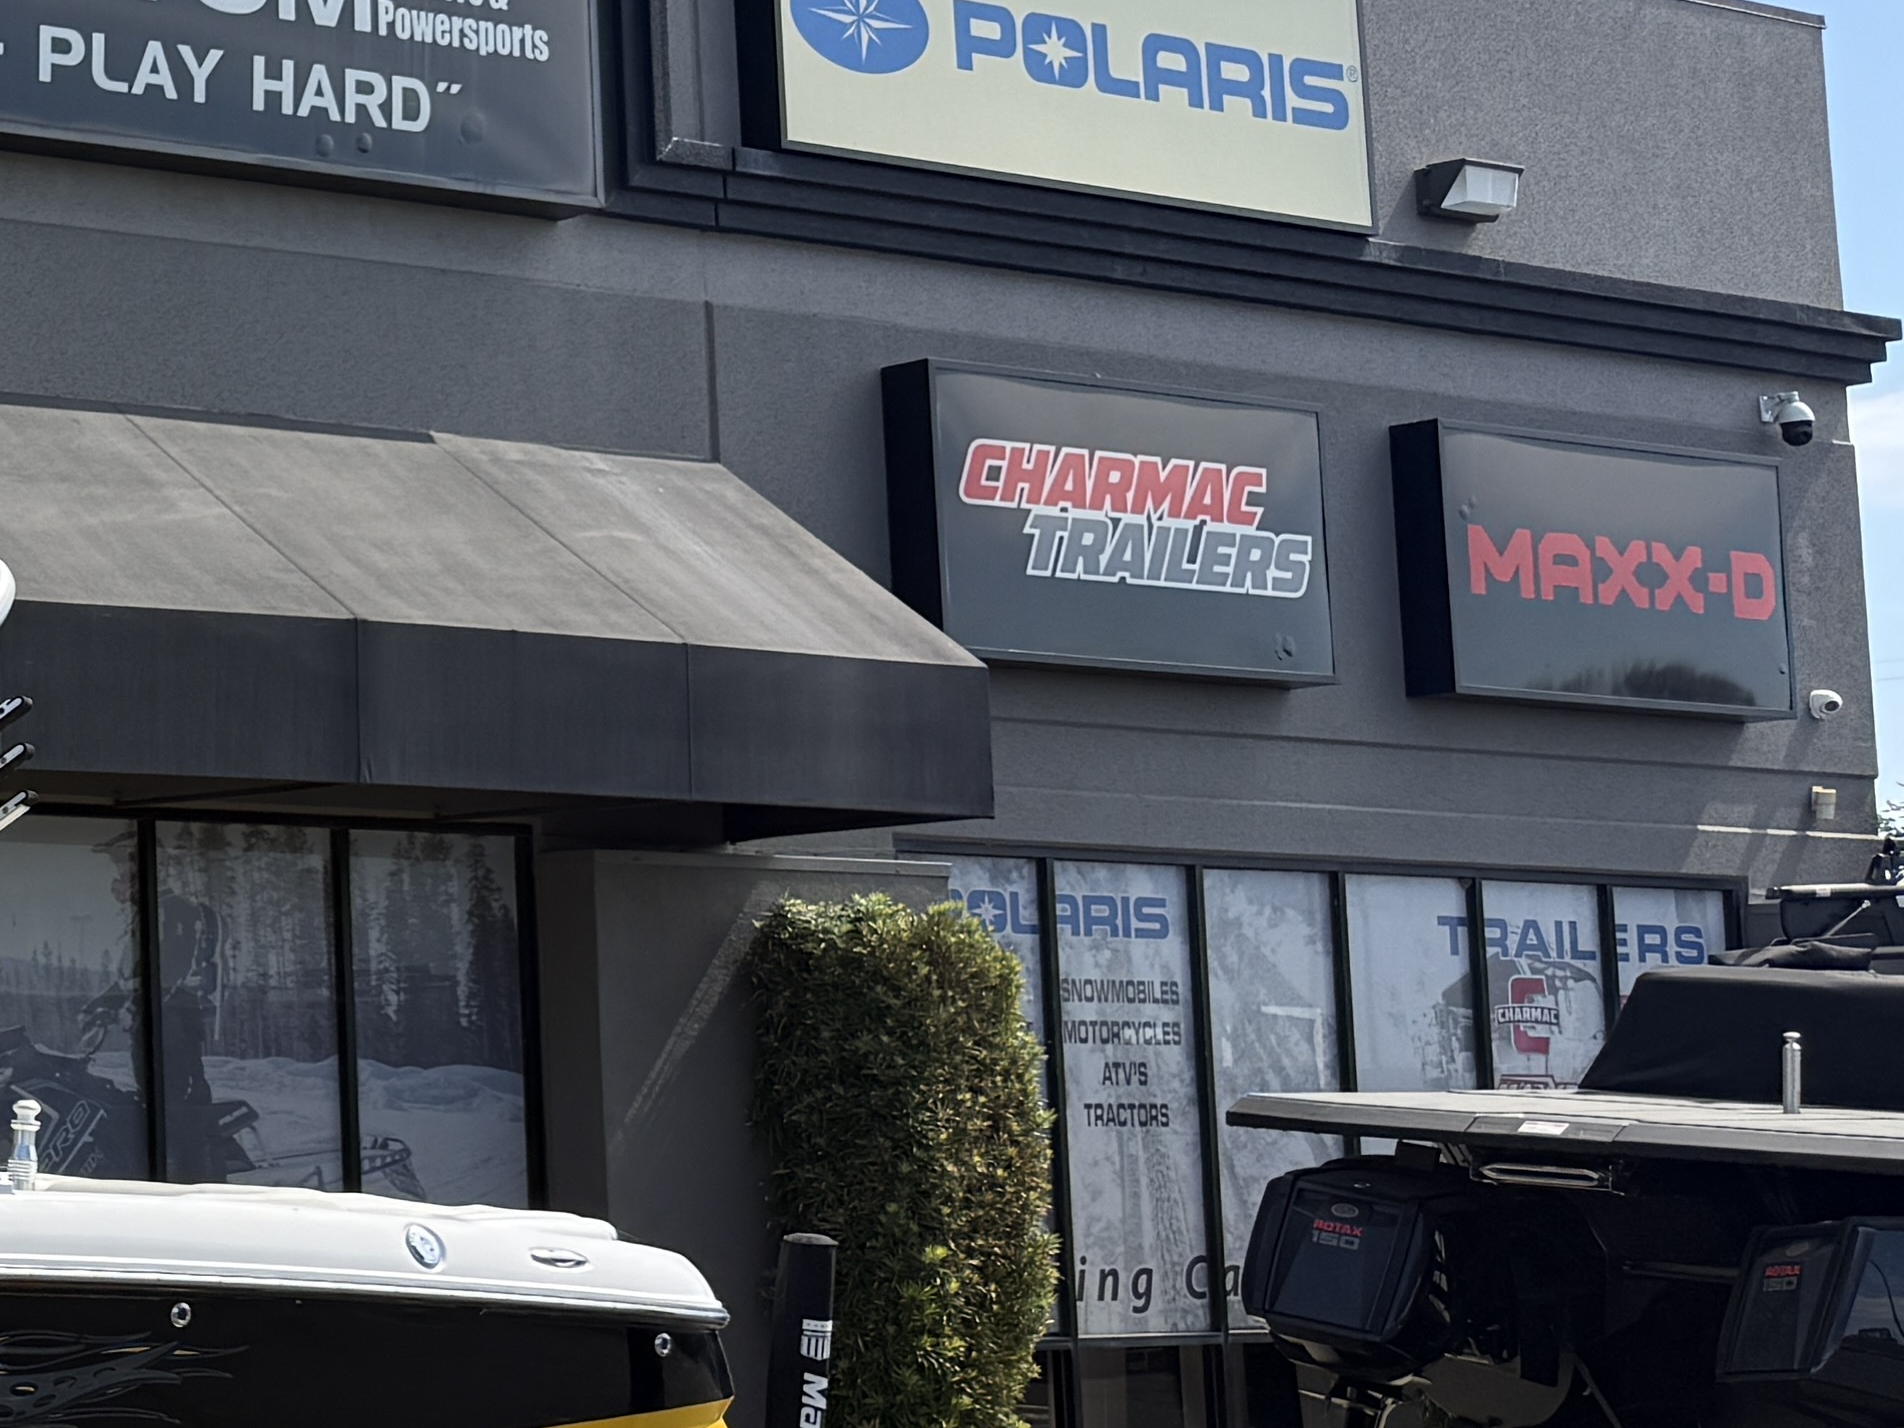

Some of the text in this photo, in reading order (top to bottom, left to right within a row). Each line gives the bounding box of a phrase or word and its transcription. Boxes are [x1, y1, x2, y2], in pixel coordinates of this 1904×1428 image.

[38, 24, 225, 104] PLAY
[959, 437, 1267, 528] CHARMAC
[1024, 512, 1313, 599] TRAILERS
[1468, 525, 1775, 621] MAXX-D
[949, 888, 1170, 940] OLARIS
[1437, 915, 1705, 965] TRAILERS
[1061, 978, 1180, 1006] SNOWMOBILES
[1496, 1006, 1559, 1024] CHARMAC
[1063, 1020, 1182, 1046] MOTORCYCLES
[1102, 1062, 1148, 1087] ATV'S
[1084, 1103, 1170, 1128] TRACTORS
[1312, 1230, 1360, 1250] 150
[1313, 1218, 1363, 1237] ROTAX
